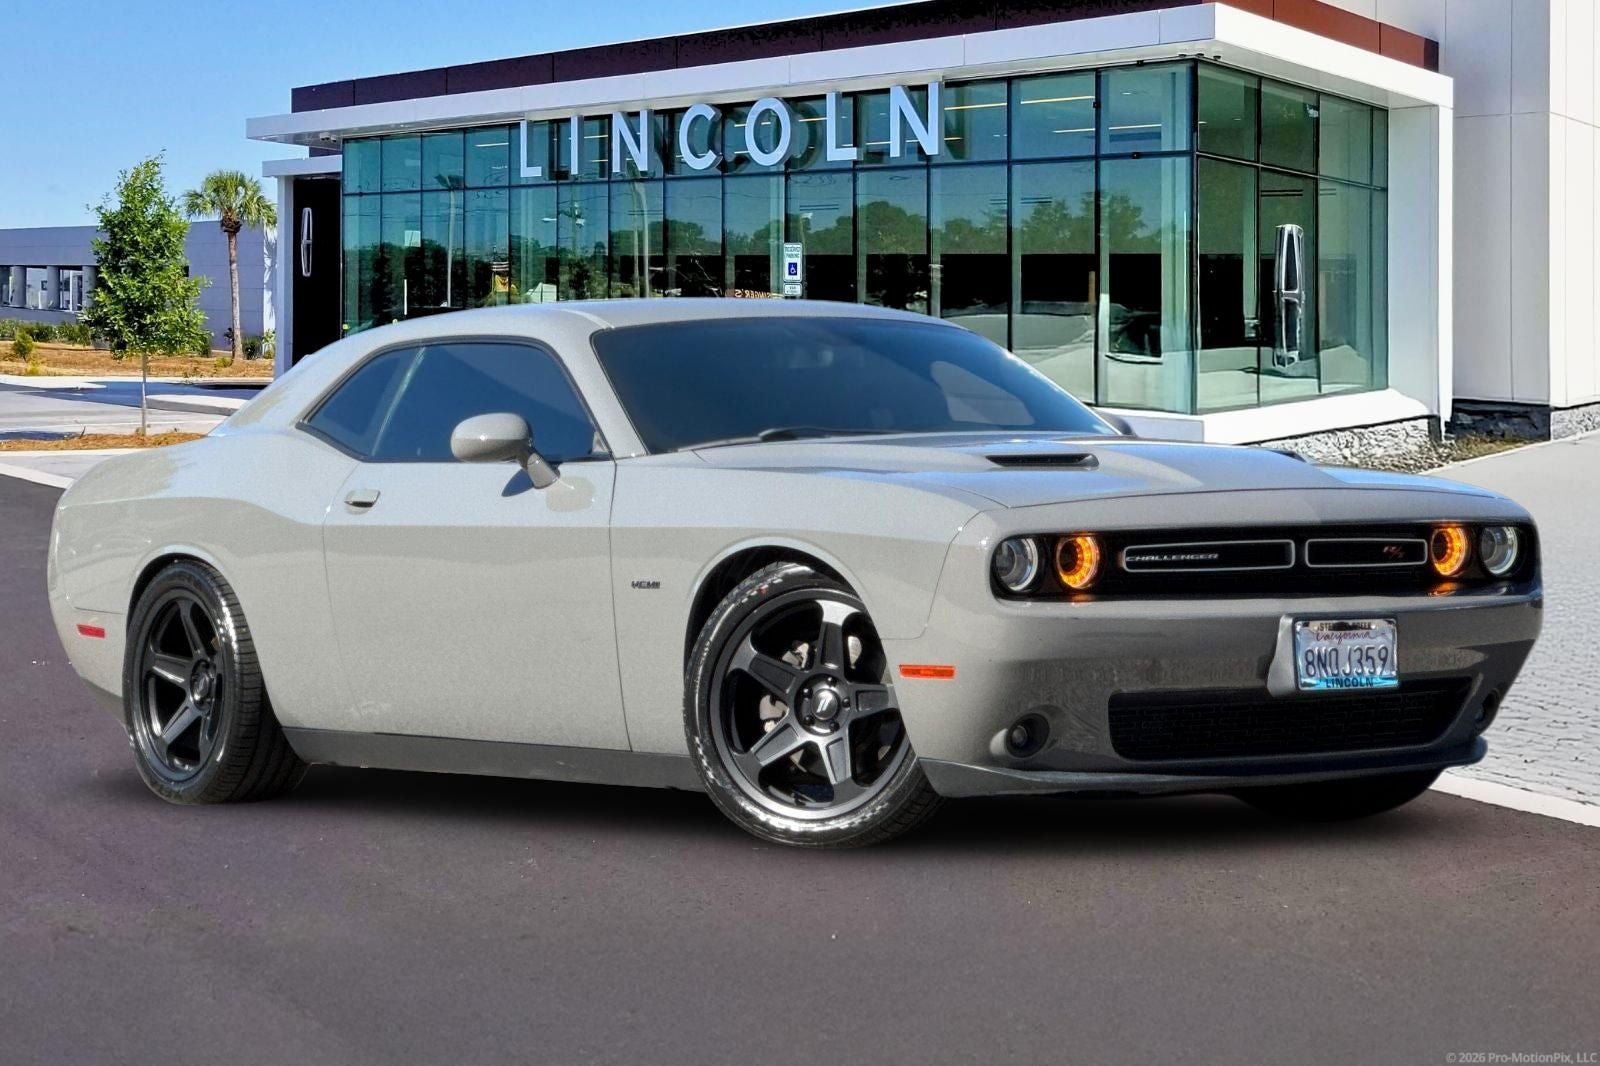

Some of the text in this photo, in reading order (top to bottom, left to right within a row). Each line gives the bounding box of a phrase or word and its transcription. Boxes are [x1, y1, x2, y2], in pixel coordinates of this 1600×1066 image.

[519, 81, 943, 179] LINCOLN
[1125, 553, 1219, 562] CHALLENGER
[1316, 630, 1377, 645] California
[1325, 677, 1374, 689] LINCOLN
